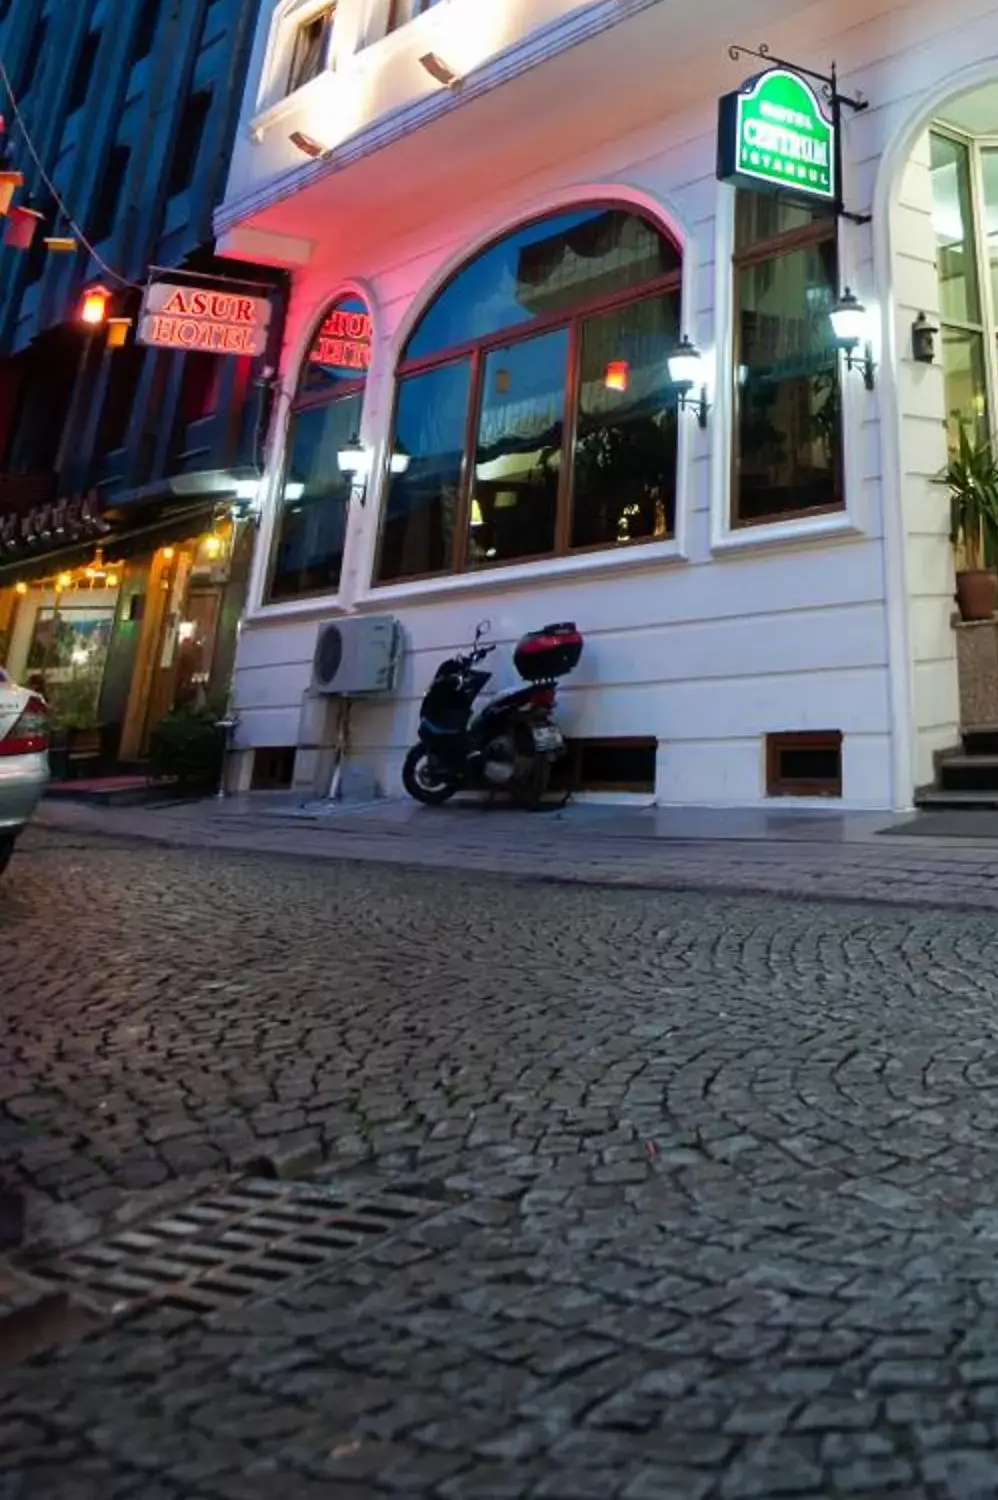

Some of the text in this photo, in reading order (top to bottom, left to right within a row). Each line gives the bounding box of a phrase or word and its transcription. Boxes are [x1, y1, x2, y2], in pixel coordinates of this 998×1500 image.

[758, 100, 813, 129] HOTEL
[743, 118, 828, 167] CENTRUM
[164, 289, 255, 323] ASUR
[152, 315, 256, 351] HOTEL
